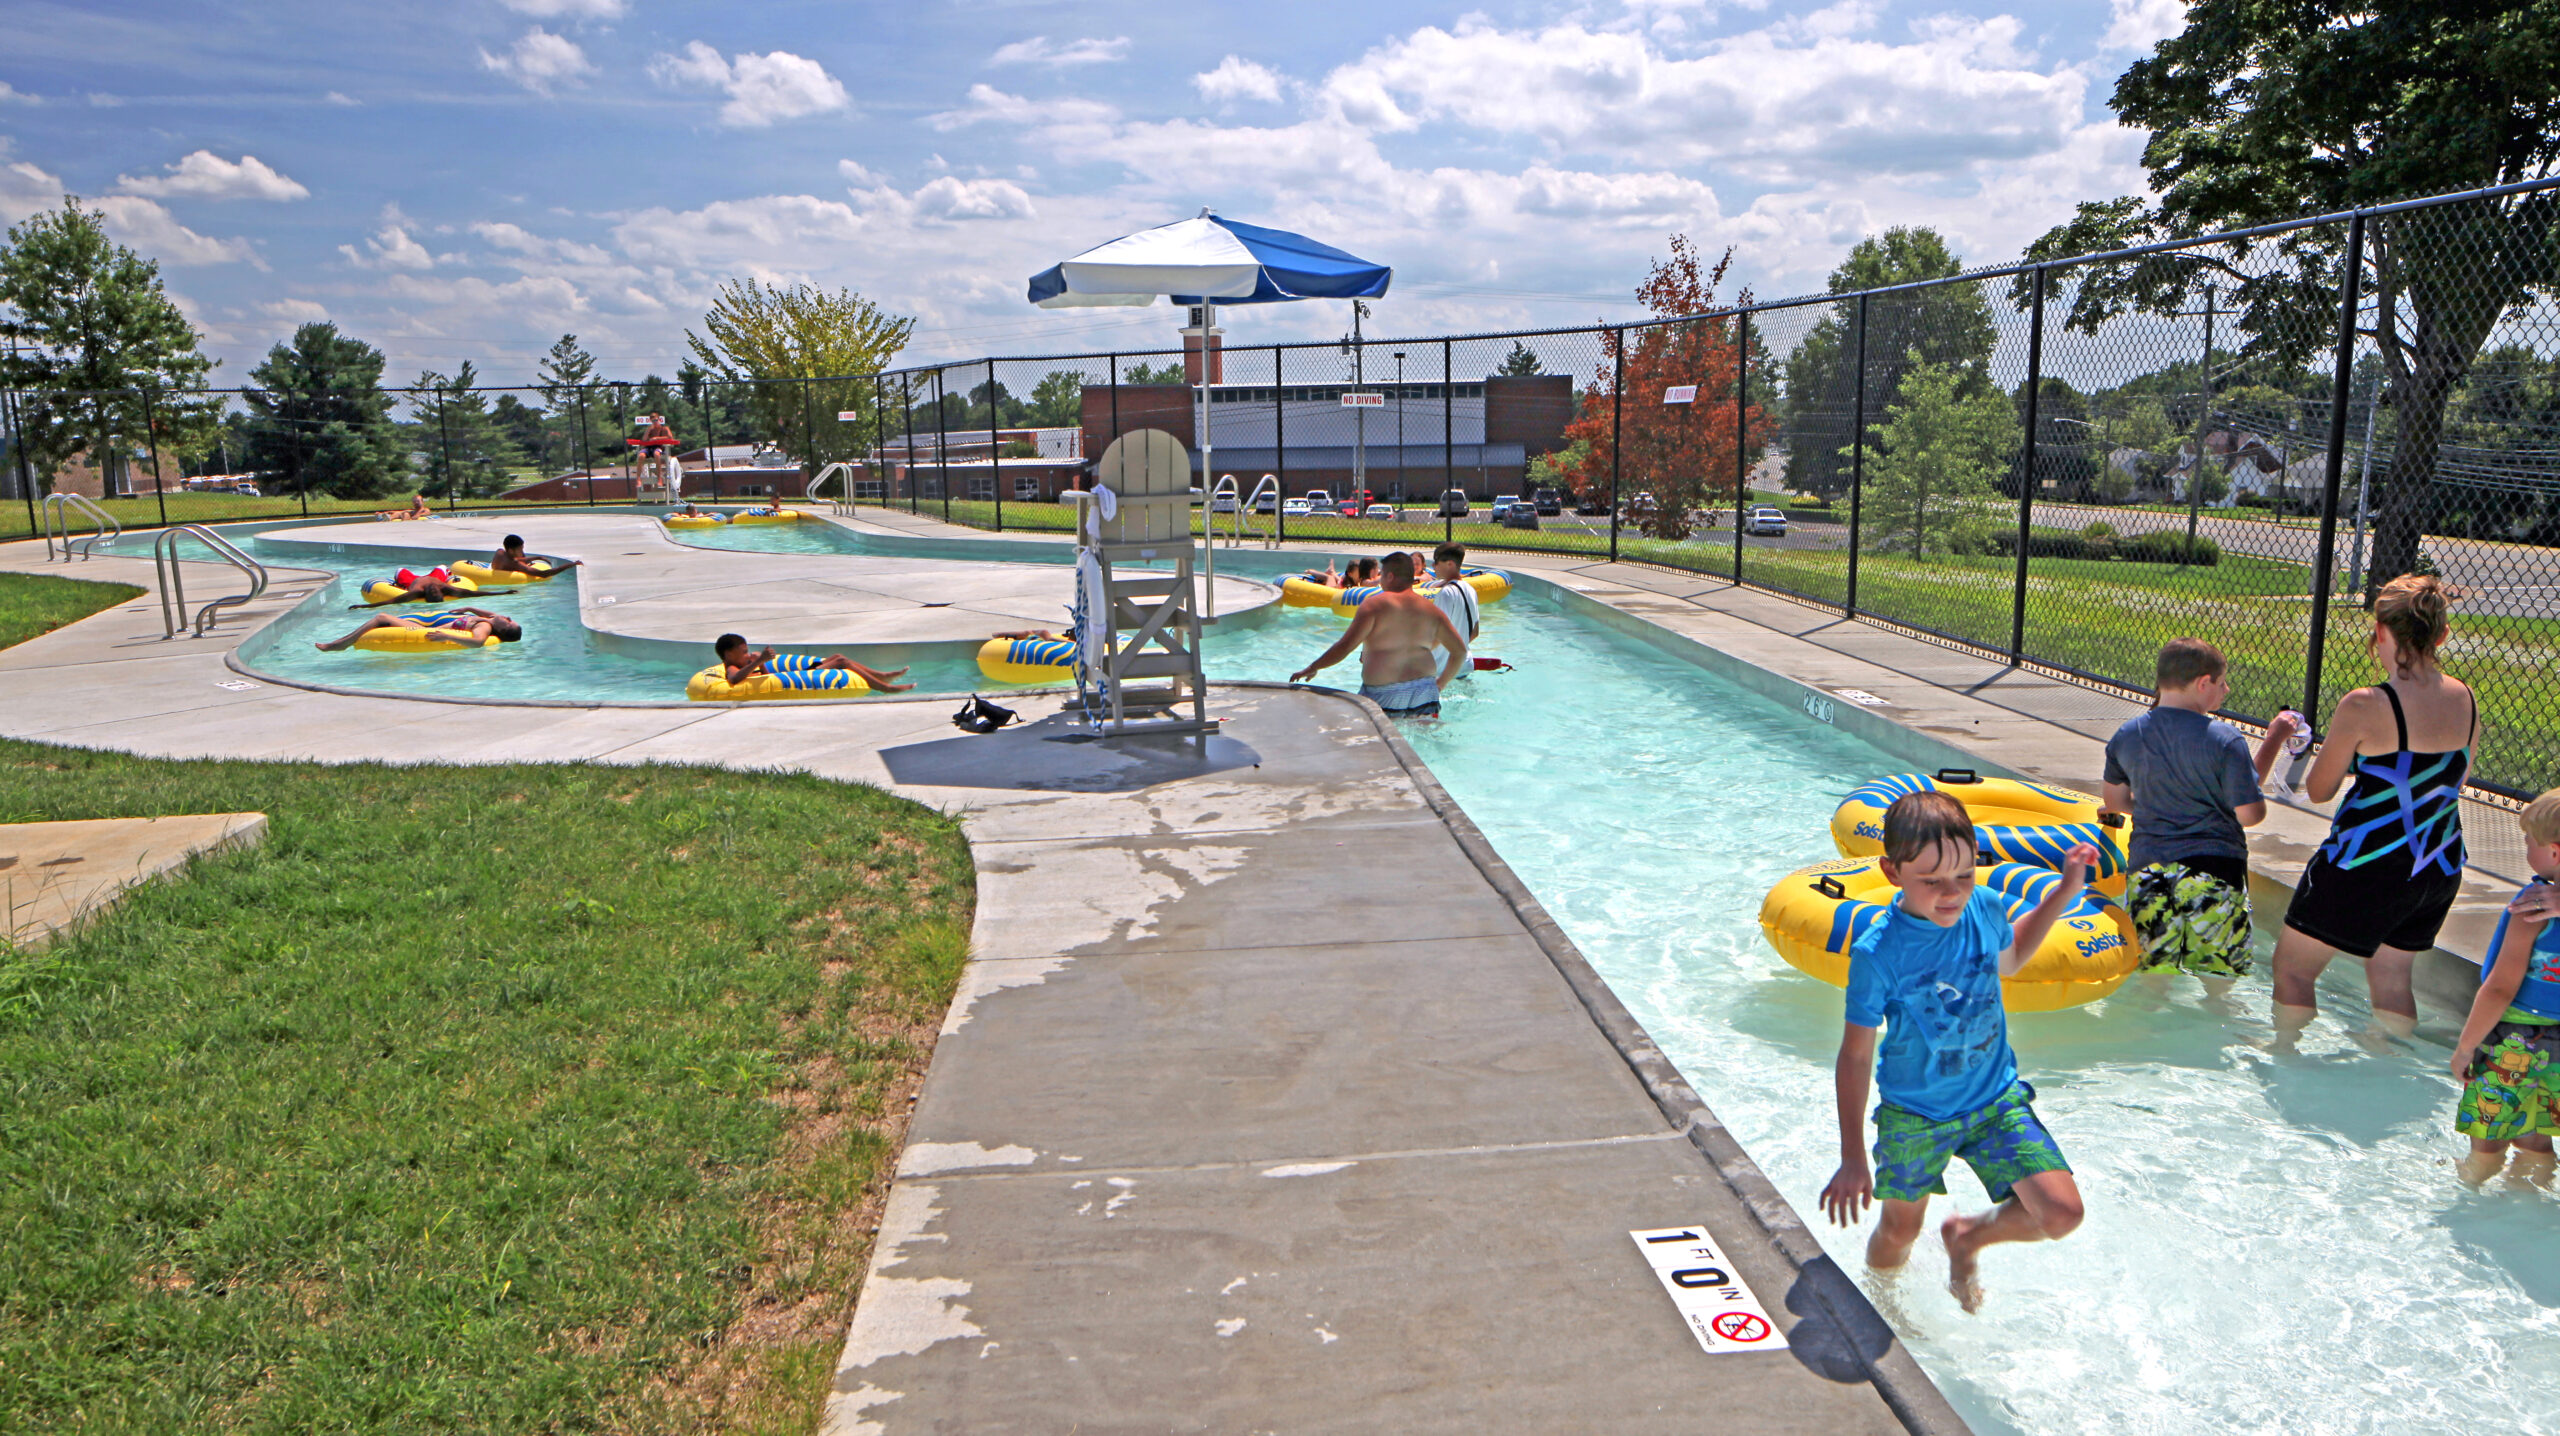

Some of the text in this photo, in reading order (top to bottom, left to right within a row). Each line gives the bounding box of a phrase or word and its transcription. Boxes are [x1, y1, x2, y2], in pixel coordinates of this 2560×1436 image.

[1343, 395, 1382, 405] NO DIVING
[1853, 821, 1886, 842] Solst
[2076, 931, 2128, 958] Solstice
[1690, 1247, 1715, 1260] FT
[1718, 1287, 1745, 1301] IN
[1696, 1324, 1716, 1347] DIVING
